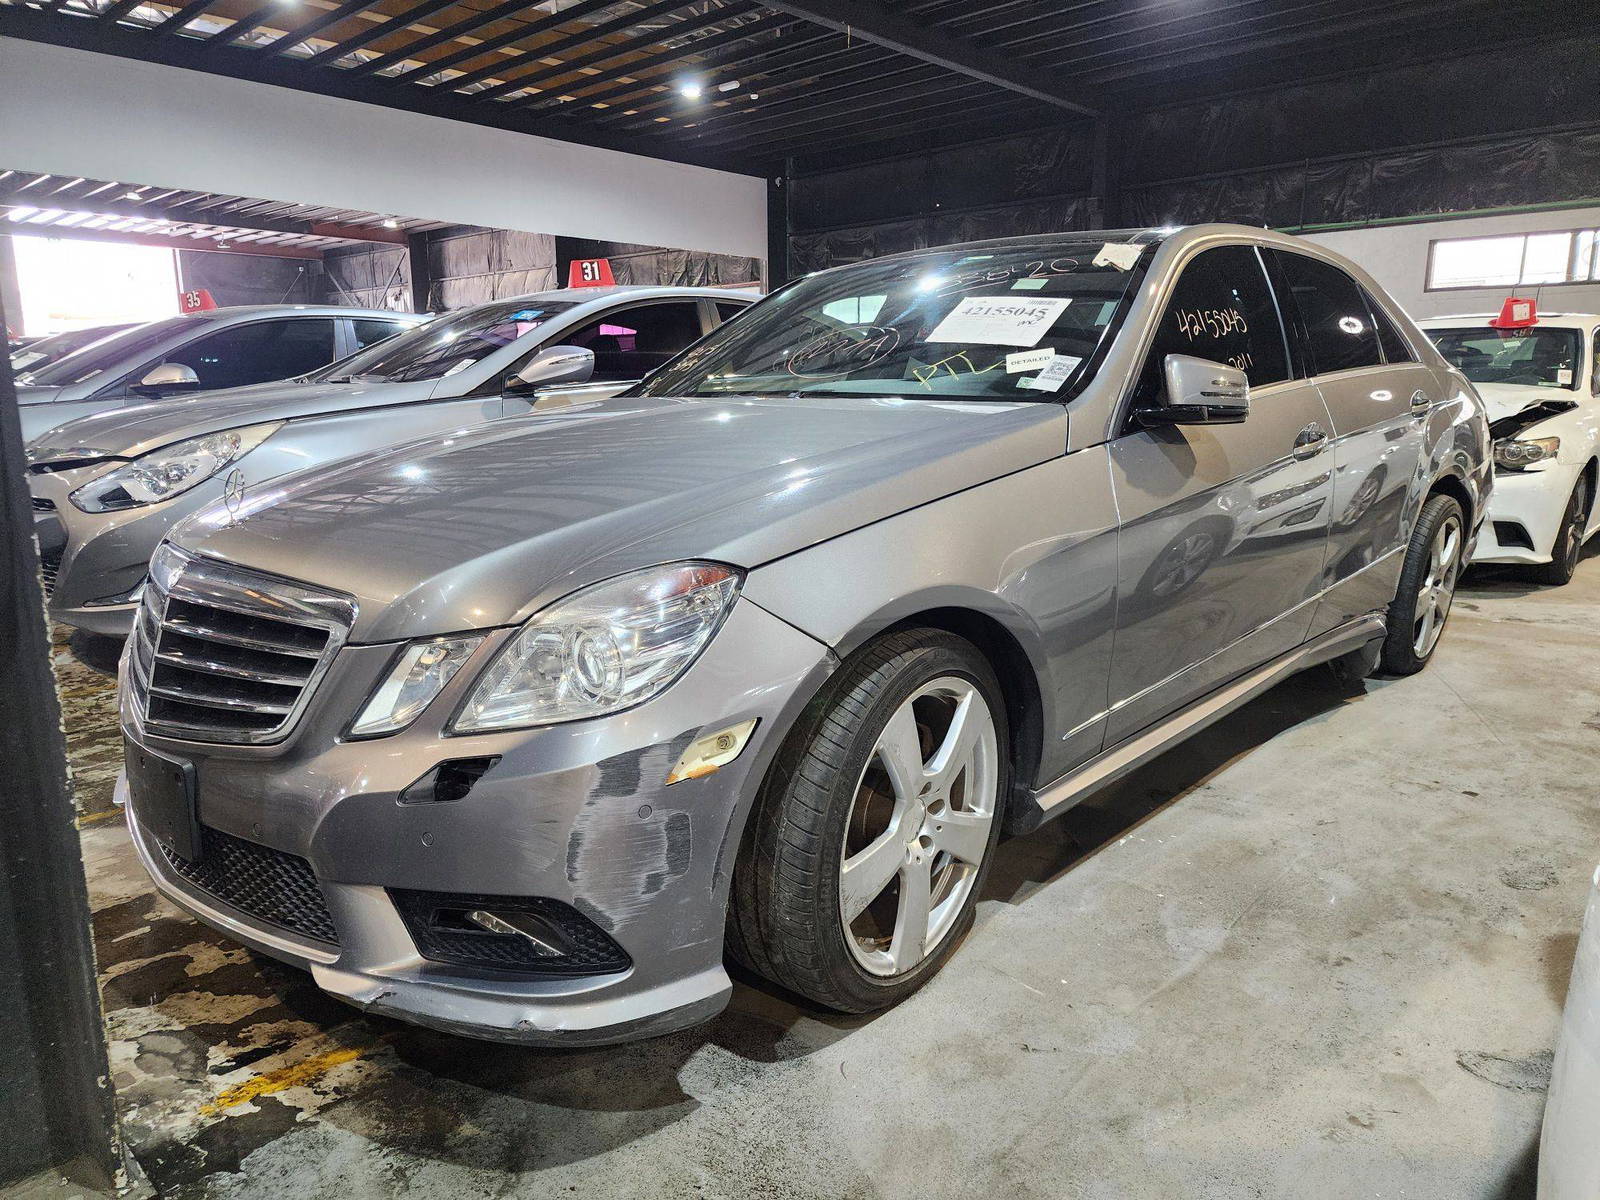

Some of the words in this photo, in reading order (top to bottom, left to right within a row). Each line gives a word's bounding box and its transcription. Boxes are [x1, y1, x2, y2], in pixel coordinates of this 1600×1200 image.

[582, 262, 600, 281] 31
[186, 291, 201, 308] 35
[962, 306, 1049, 317] 42155045
[1176, 308, 1248, 342] 42155045
[1010, 356, 1050, 366] DETAILED
